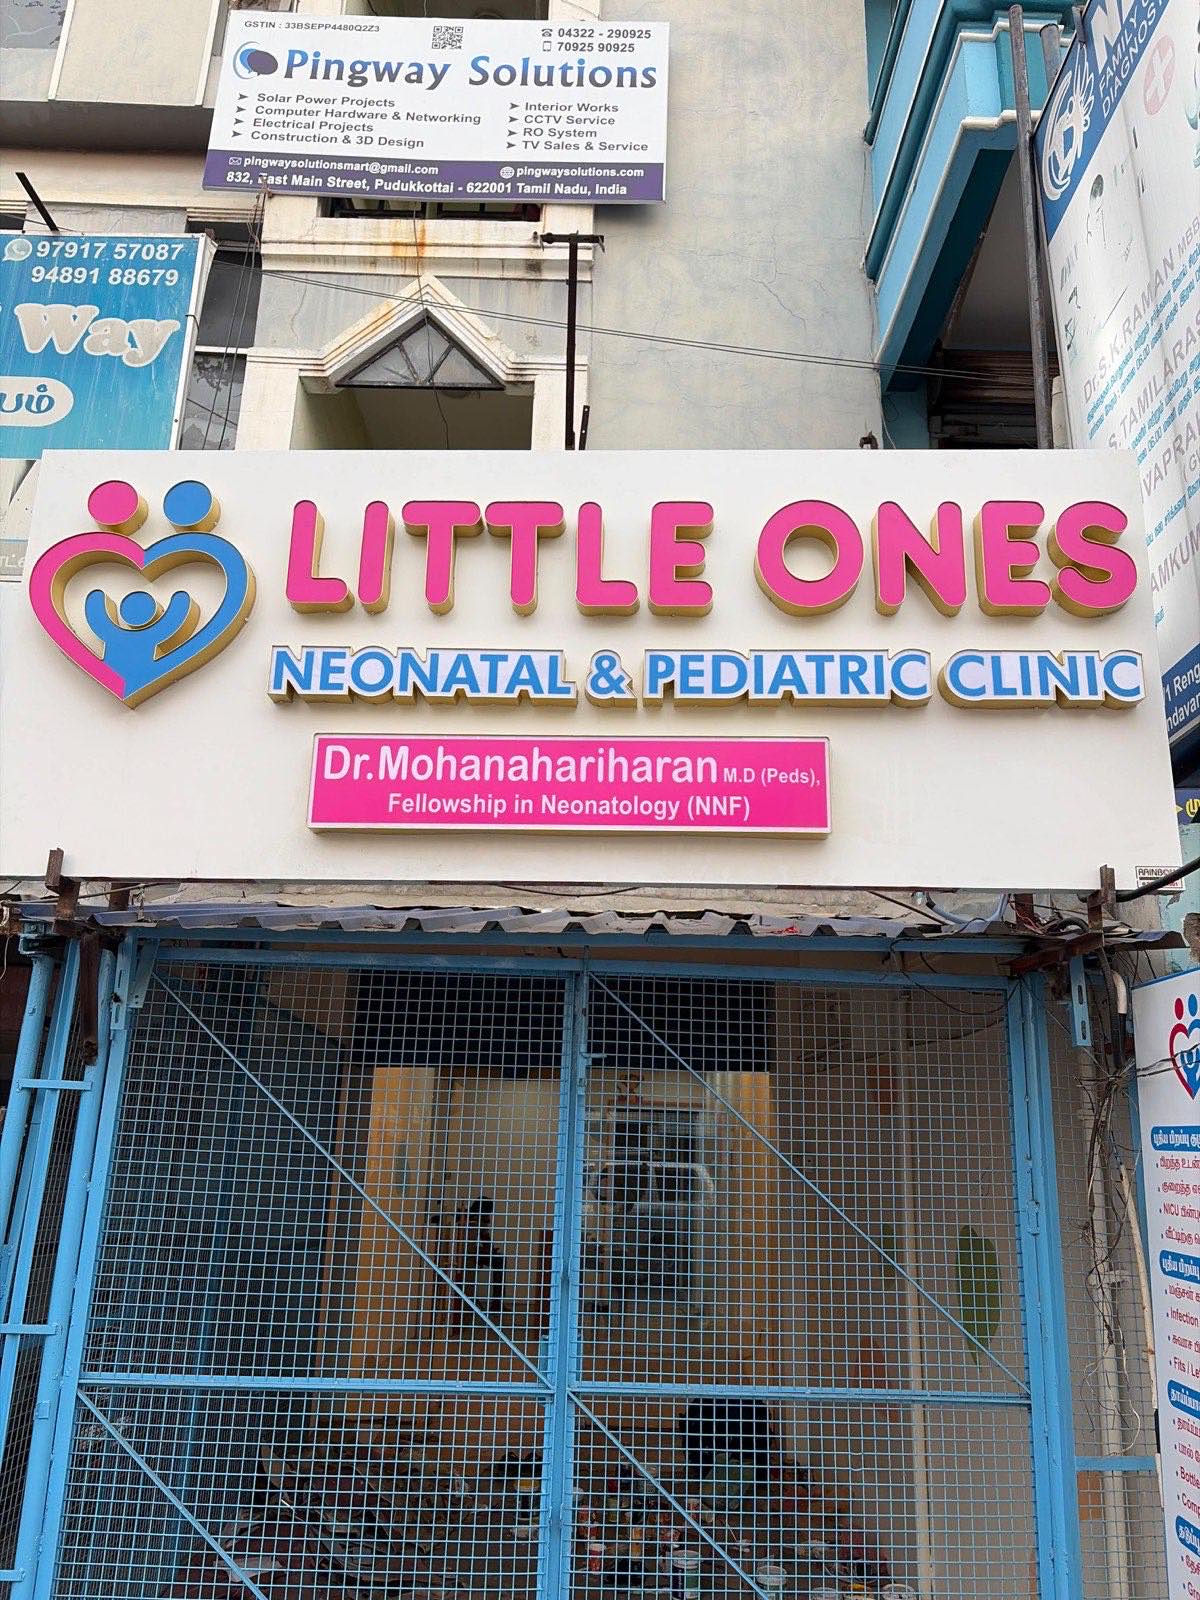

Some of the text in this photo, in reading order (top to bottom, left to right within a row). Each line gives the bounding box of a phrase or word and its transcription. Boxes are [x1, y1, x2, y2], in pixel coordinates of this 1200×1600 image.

[244, 20, 276, 28] GSTIN
[558, 28, 595, 38] 04322
[607, 29, 651, 39] 290925
[557, 42, 635, 52] 70925 90925
[1099, 5, 1138, 98] FAMILY
[1102, 0, 1163, 118] DIAGNOS
[284, 49, 657, 91] Pingway Solutions
[257, 93, 395, 108] Solar Power Projects
[525, 102, 619, 113] Interior Works
[255, 105, 481, 125] Computer Hardware & Networking
[524, 115, 616, 125] CCTV Service
[253, 118, 374, 133] Electrical Projects
[523, 128, 597, 139] RO System
[251, 131, 424, 149] Construction & 3D Design
[522, 140, 648, 151] TV Sales & Service
[243, 156, 439, 175] pingwaysolutionsmart@gmail.com
[516, 166, 644, 178] pingwaysolutions.com
[226, 171, 253, 184] 832,
[291, 174, 322, 187] Main
[327, 176, 370, 191] Street,
[374, 178, 454, 193] Pudukkottai
[466, 182, 512, 194] 622001
[517, 183, 550, 194] Tamil
[554, 183, 592, 196] Nadu,
[595, 183, 627, 195] India
[36, 240, 184, 261] 97917 57087
[31, 266, 179, 286] 94891 88679
[14, 303, 181, 368] Way
[285, 499, 715, 613] LITTLE
[754, 499, 1138, 613] ONES
[270, 647, 1143, 700] NEONATAL & PEDIATRIC CLINIC
[323, 745, 821, 787] Dr.Mohanahariharan M.D (Peds),
[388, 793, 751, 821] Fellowship in Neonatology (NNF)
[1138, 868, 1176, 877] RAINBO
[1163, 1202, 1180, 1217] NICU
[1170, 1306, 1199, 1328] Infection
[1173, 1356, 1186, 1373] Fits
